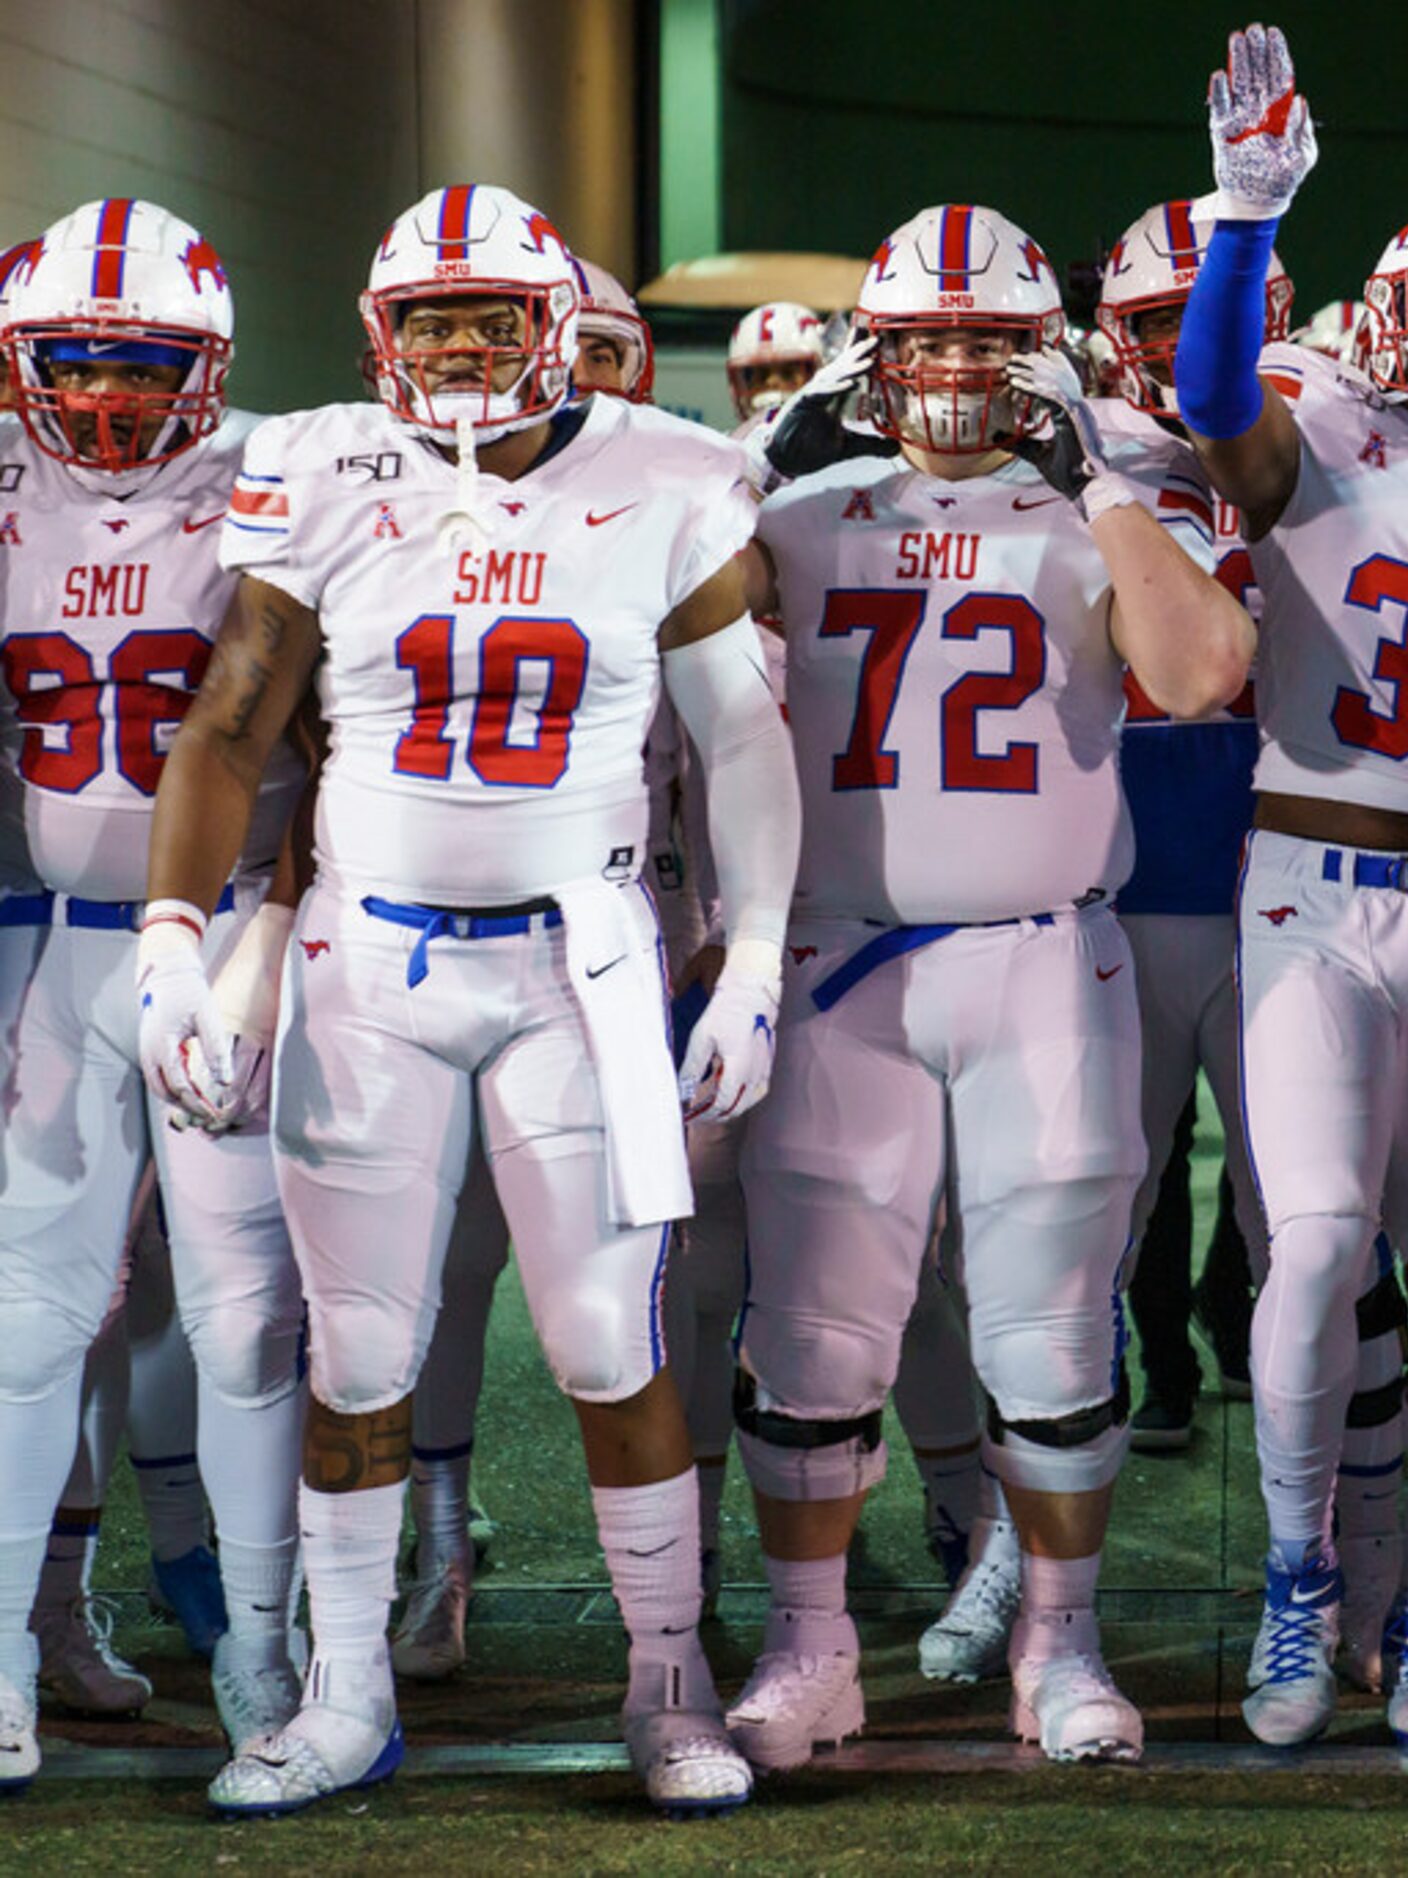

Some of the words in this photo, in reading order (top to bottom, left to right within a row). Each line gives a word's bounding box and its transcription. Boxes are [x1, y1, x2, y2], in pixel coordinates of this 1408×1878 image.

[434, 263, 471, 278] SMU
[937, 293, 975, 309] SMU
[335, 450, 402, 488] 150
[453, 549, 547, 605] SMU
[896, 532, 981, 580] SMU
[62, 563, 150, 618] SMU
[391, 614, 591, 790] 10
[817, 588, 1048, 795] 72
